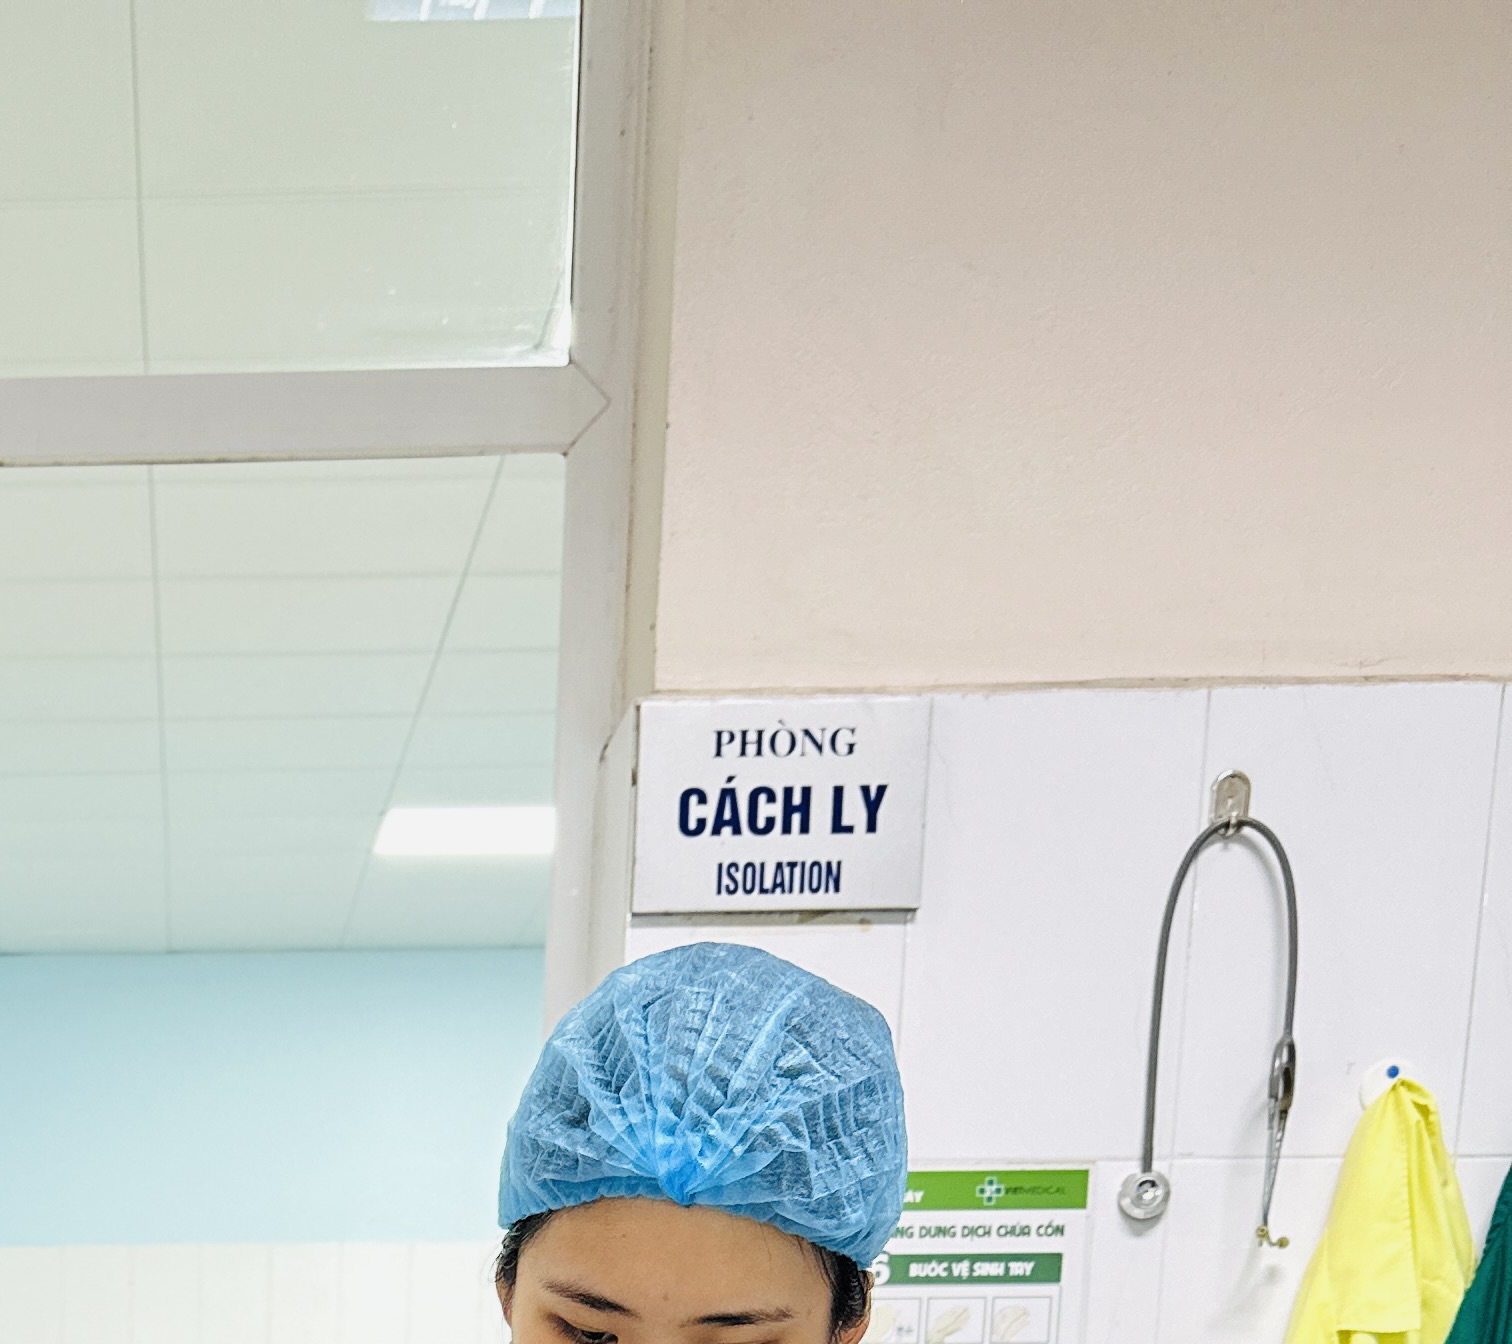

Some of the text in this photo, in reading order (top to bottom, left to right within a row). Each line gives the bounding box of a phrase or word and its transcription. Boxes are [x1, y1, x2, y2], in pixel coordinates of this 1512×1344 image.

[713, 720, 858, 758] PHÒNG
[678, 775, 890, 838] CÁCH LY
[716, 861, 842, 896] ISOLATION
[872, 1252, 891, 1285] 6
[972, 1261, 1005, 1276] SINH
[1008, 1260, 1035, 1276] TAY
